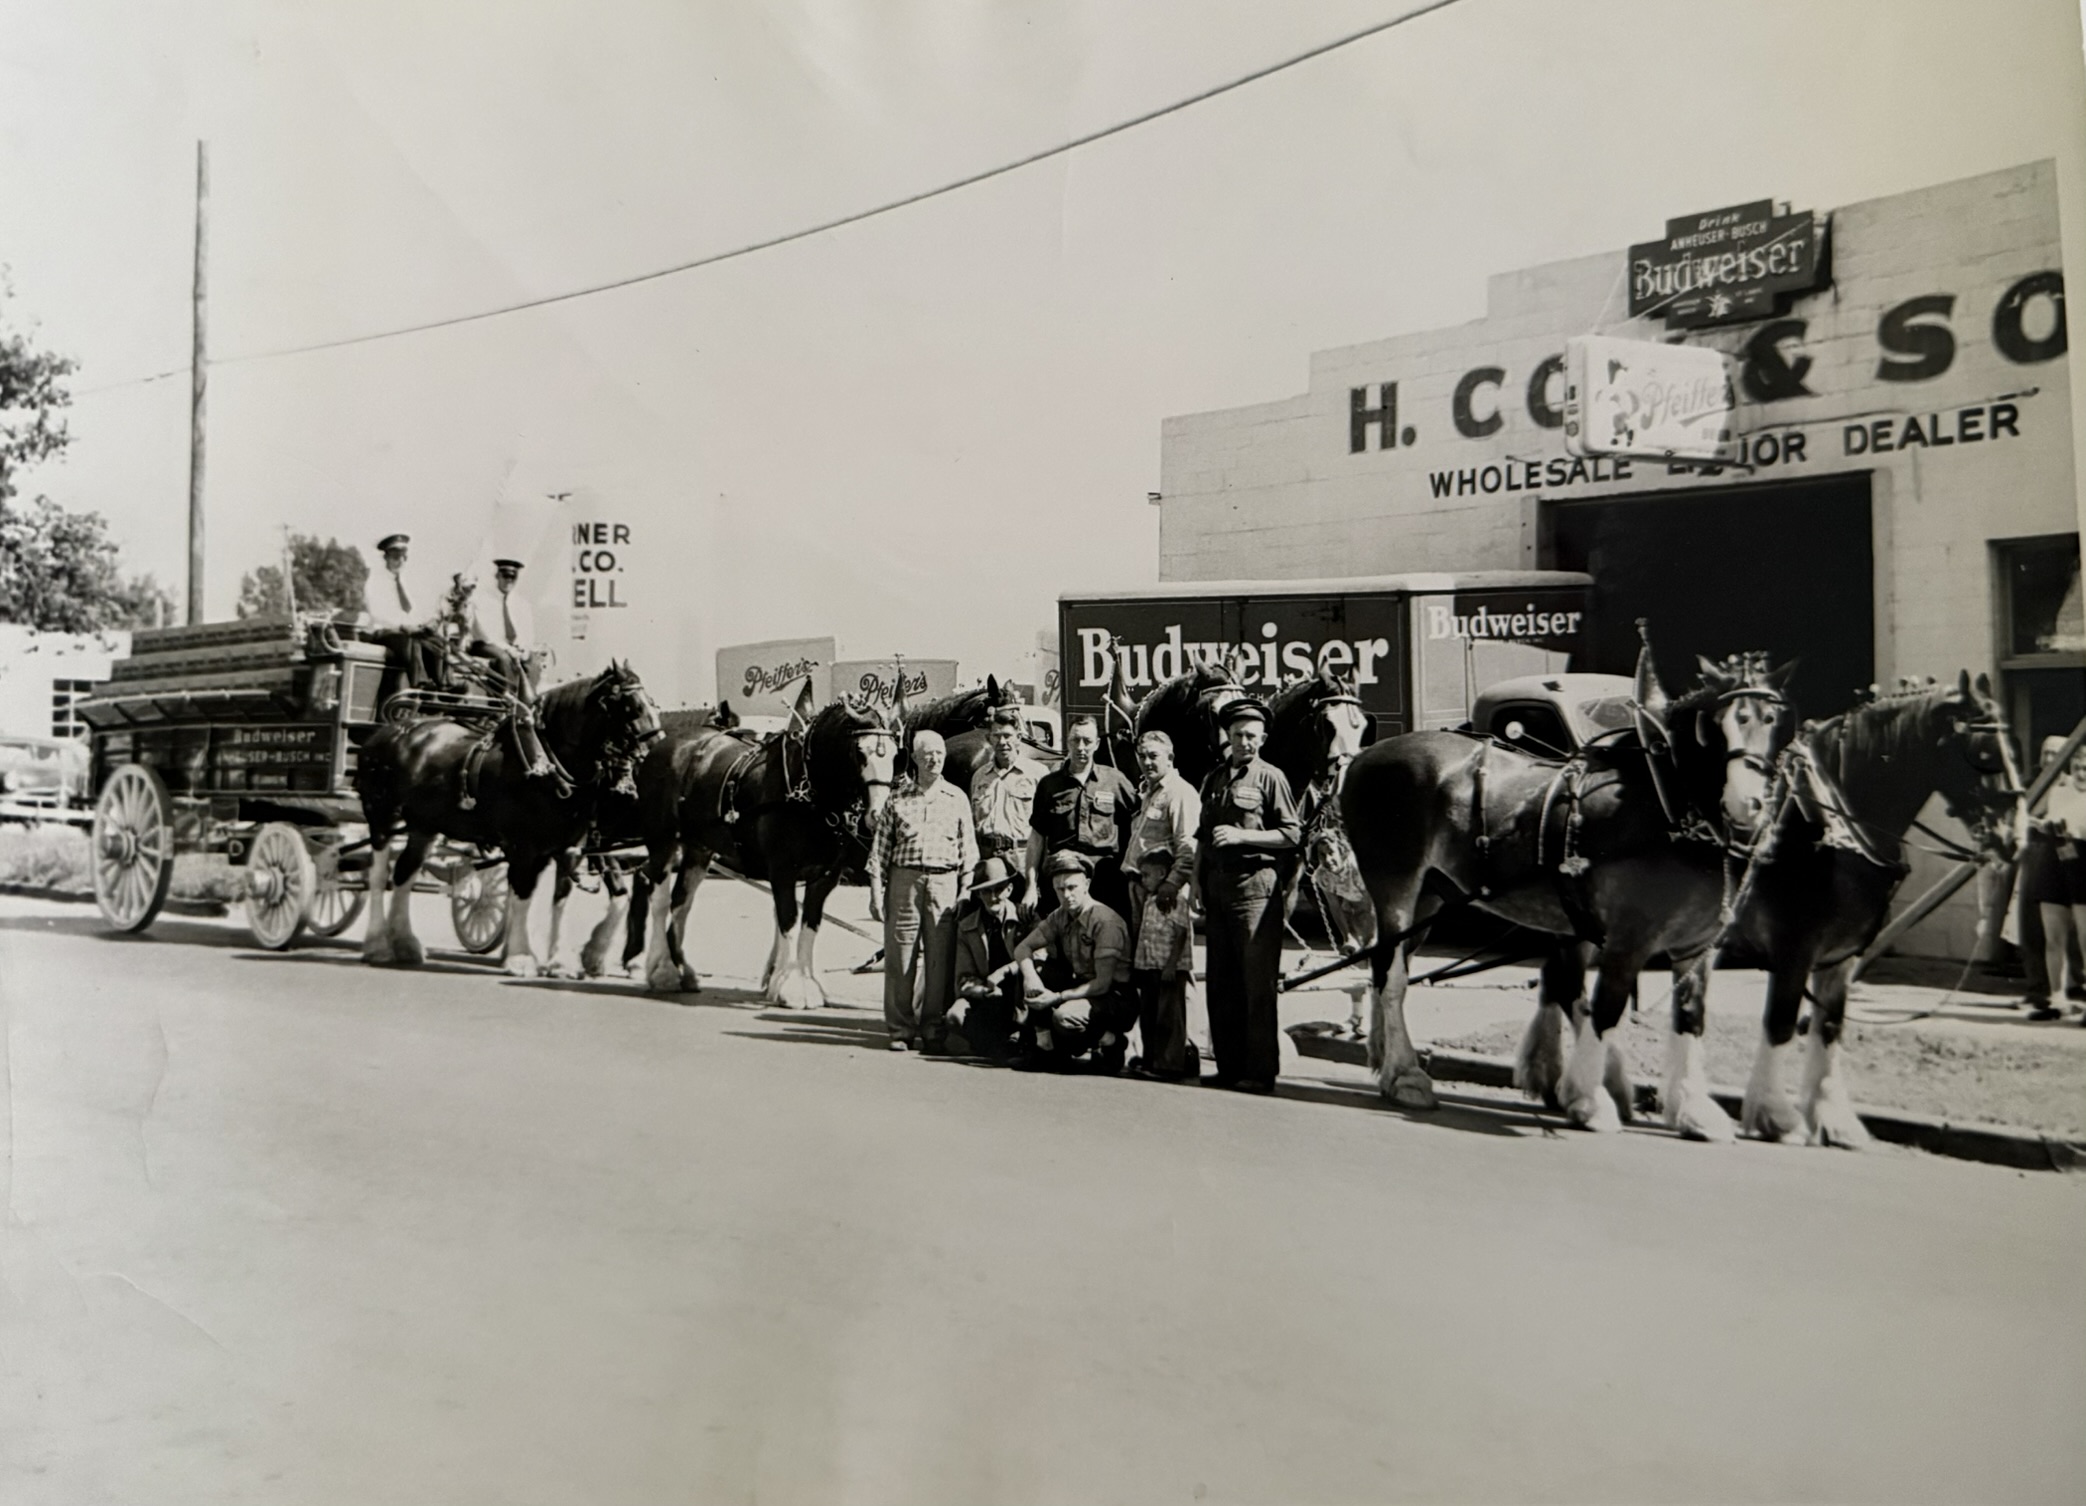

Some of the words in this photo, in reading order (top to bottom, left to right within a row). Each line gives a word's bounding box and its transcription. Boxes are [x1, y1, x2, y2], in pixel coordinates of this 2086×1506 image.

[1669, 219, 1769, 251] ANHEUSER-BUSCH
[1698, 212, 1742, 231] Drink
[1633, 239, 1806, 301] Budweiser
[1349, 379, 1417, 455] H.
[1741, 319, 1821, 404] &
[1429, 453, 1634, 499] WHOLESALE
[1844, 403, 2021, 457] DEALER
[574, 578, 628, 609] ELL
[1426, 603, 1583, 641] Budweiser
[1077, 622, 1389, 687] Budweiser
[742, 657, 813, 698] Pfeiffer's
[859, 670, 929, 706] Pfeier's
[233, 728, 317, 744] Budweiser
